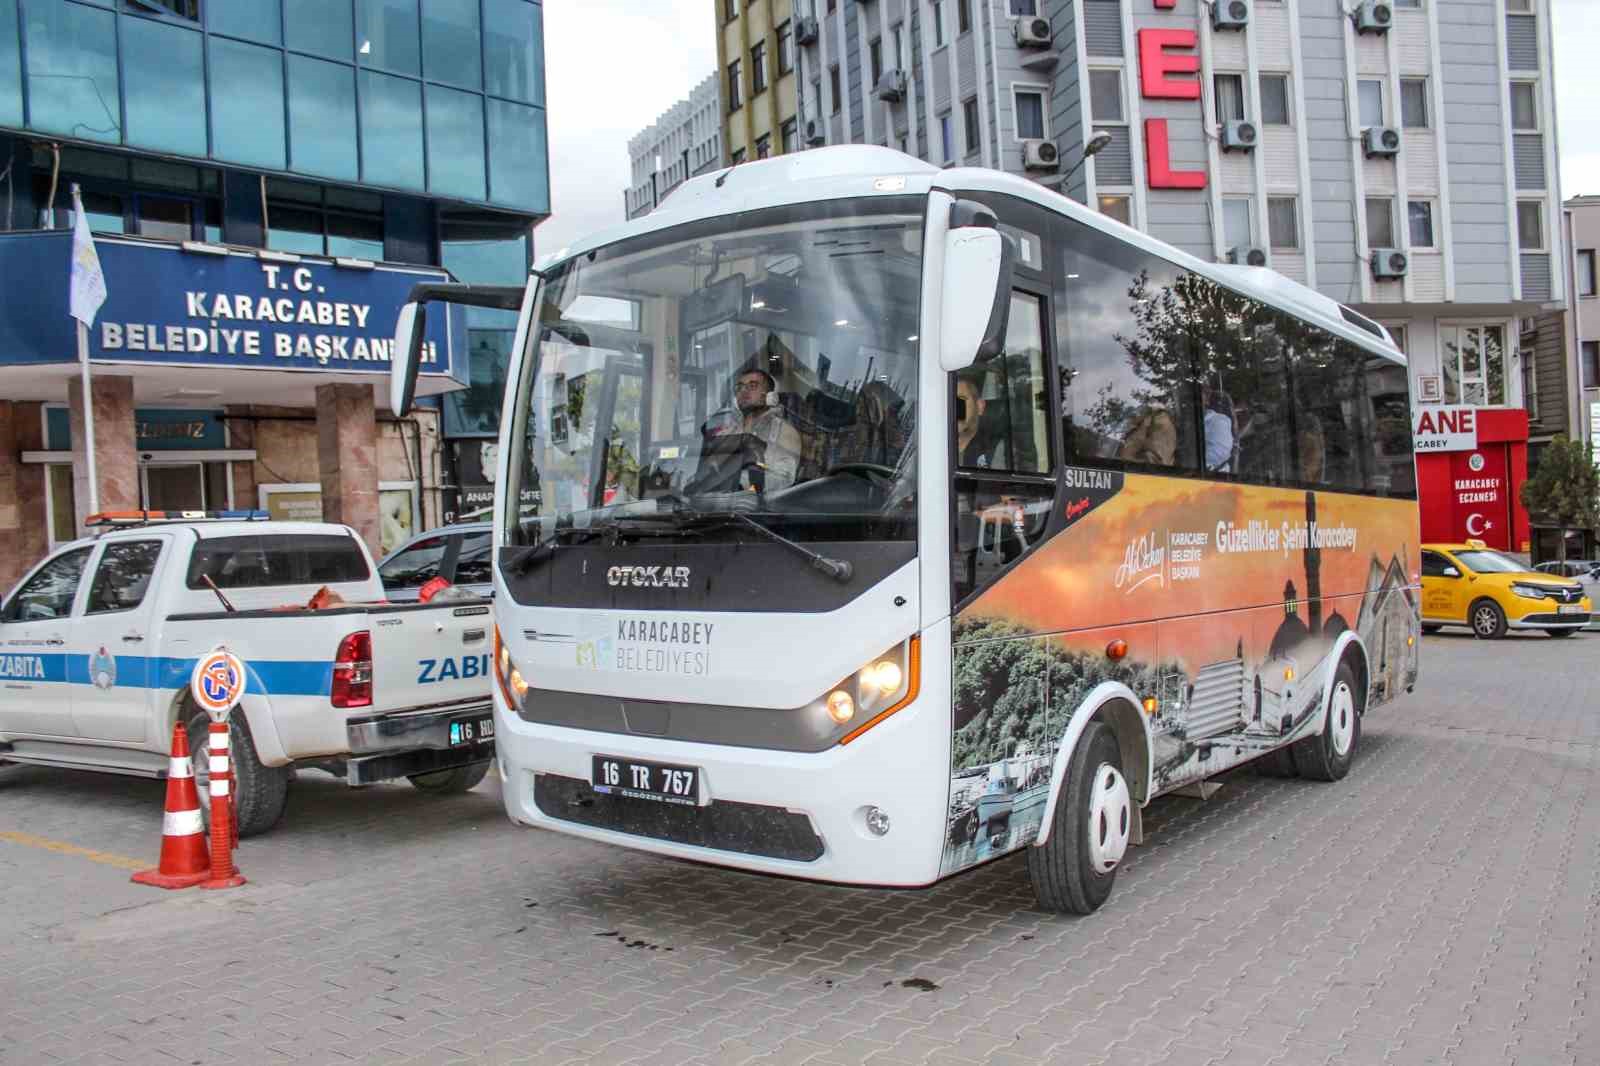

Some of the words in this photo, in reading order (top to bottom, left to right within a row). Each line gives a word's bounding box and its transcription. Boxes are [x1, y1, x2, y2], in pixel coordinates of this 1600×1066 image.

[1138, 0, 1207, 190] EL
[186, 291, 370, 328] KARACABEY
[101, 320, 260, 355] BELEDİYE
[1413, 409, 1474, 436] ANE
[1414, 440, 1448, 450] CABEY
[1065, 469, 1111, 489] SULTAN
[1455, 479, 1499, 490] KARACABEY
[1459, 491, 1497, 504] ECZANESİ
[1216, 519, 1280, 553] Güzellikler
[607, 566, 690, 588] OTOKAR
[618, 619, 714, 645] KARACABEY
[0, 655, 45, 678] ZABITA
[417, 653, 493, 684] ZABI
[616, 646, 710, 676] BELEDİYESİ
[460, 722, 473, 741] 16
[603, 761, 620, 785] 16
[629, 764, 650, 789] TR
[661, 768, 693, 795] 767
